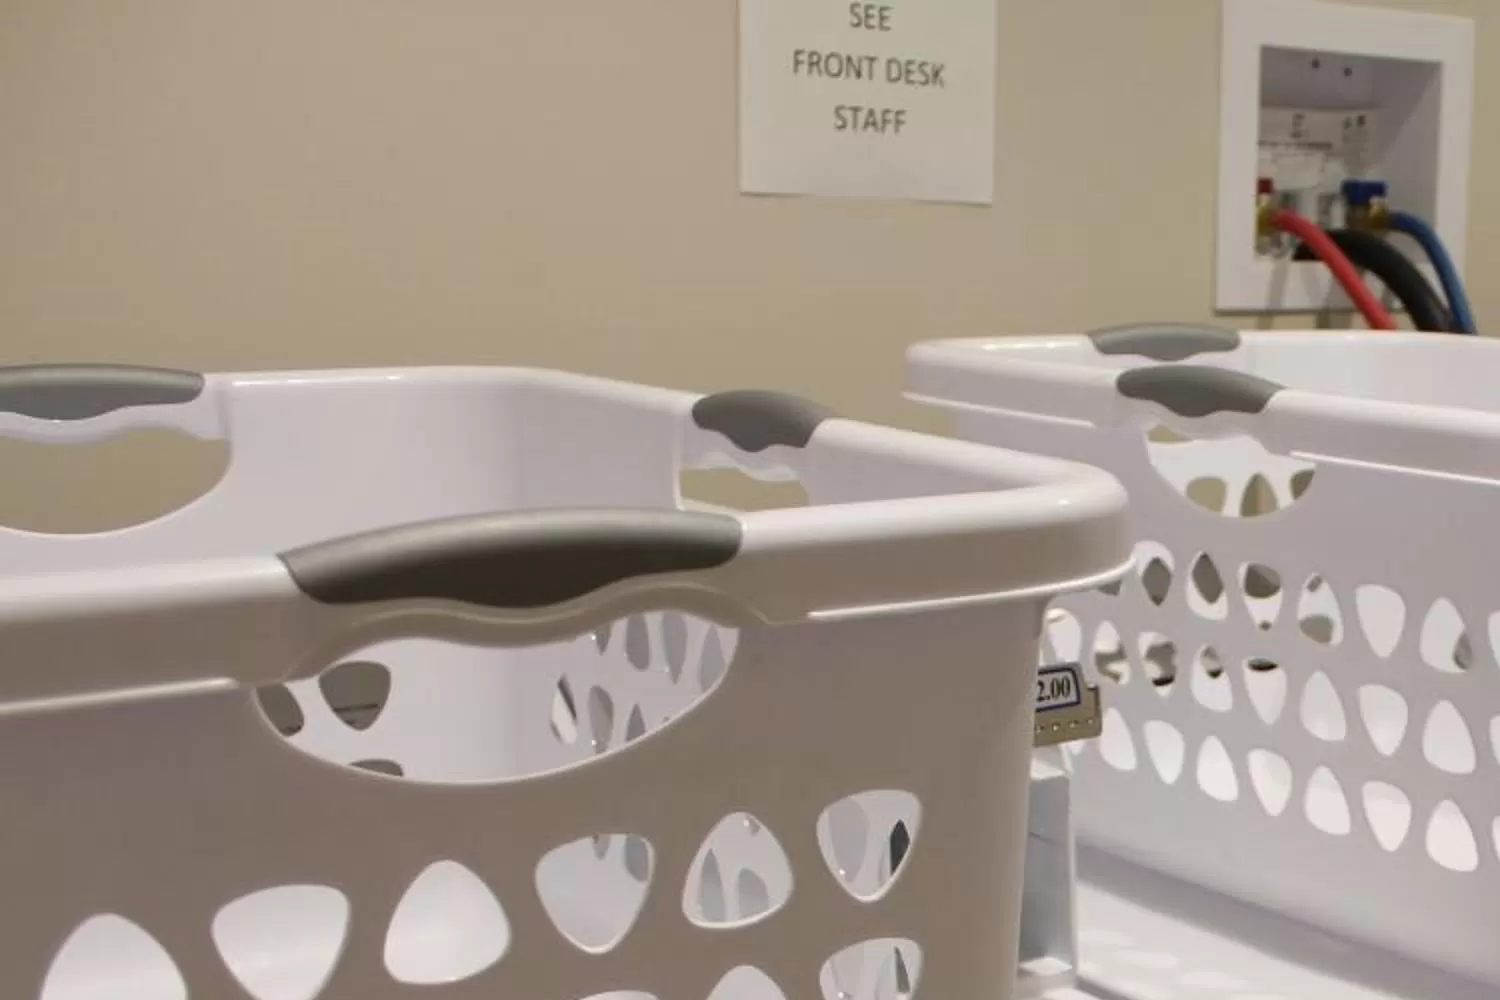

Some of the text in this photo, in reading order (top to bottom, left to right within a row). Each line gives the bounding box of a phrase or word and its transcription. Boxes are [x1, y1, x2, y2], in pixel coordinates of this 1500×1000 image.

[849, 2, 893, 31] SEE
[792, 49, 946, 88] FRONT DESK
[833, 104, 908, 134] STAFF
